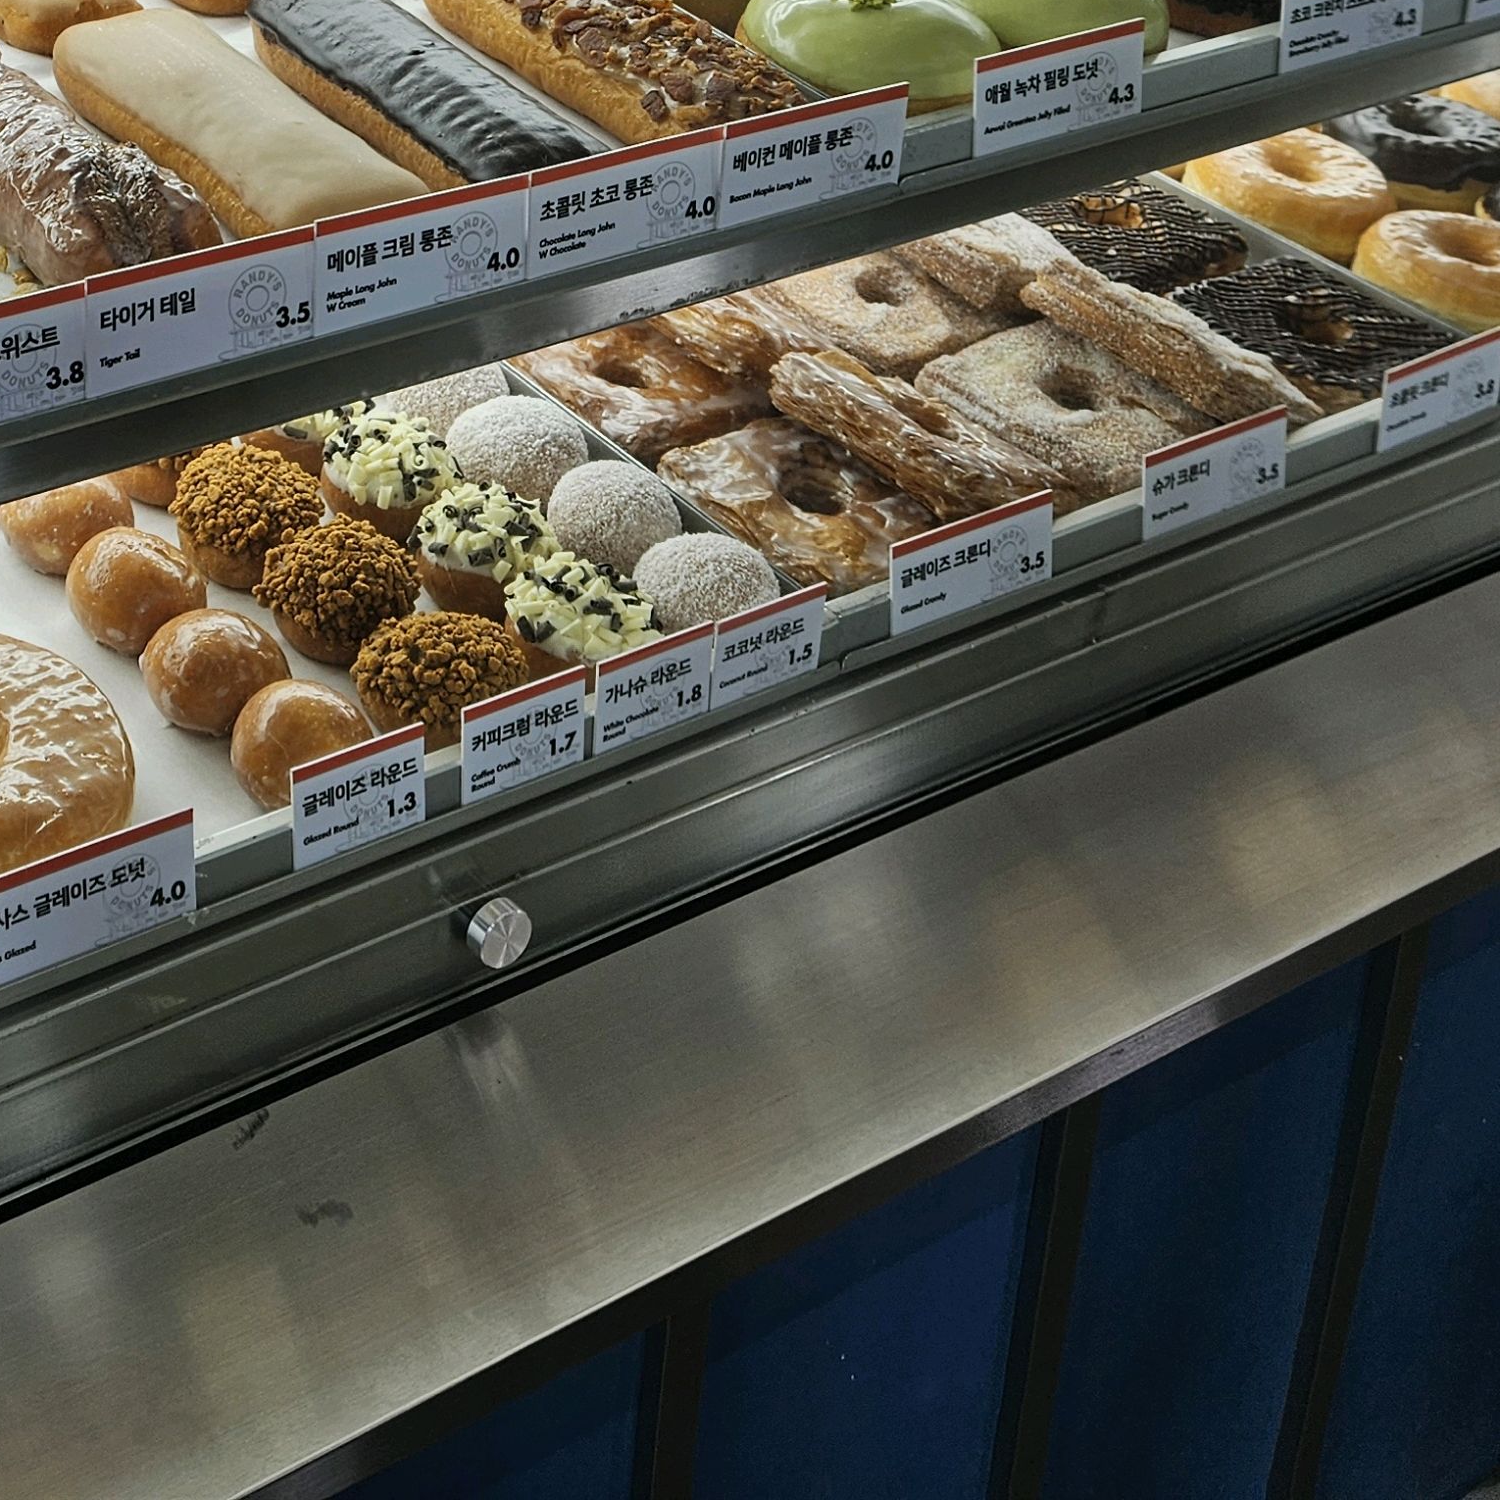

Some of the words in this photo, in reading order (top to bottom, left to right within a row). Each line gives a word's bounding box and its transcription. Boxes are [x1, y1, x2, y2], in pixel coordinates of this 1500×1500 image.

[985, 81, 1012, 105] 애월
[1014, 73, 1041, 97] 녹차
[1044, 65, 1070, 92] 필링
[1072, 58, 1099, 82] 도넛
[1108, 83, 1135, 105] 4.3
[732, 144, 775, 173] 베이컨
[779, 133, 822, 161] 메이플
[824, 126, 853, 151] 롱존
[864, 150, 894, 172] 4.0
[776, 180, 793, 191] Long
[795, 176, 812, 188] John
[539, 191, 585, 221] 초콜릿
[590, 184, 620, 209] 초코
[623, 174, 654, 200] 롱존
[685, 195, 715, 219] 4.0
[539, 232, 576, 248] Chocolate
[577, 227, 596, 238] Long
[597, 221, 615, 233] John
[327, 242, 378, 273] 메이플
[381, 233, 415, 260] 크림
[419, 225, 454, 252] 롱존
[486, 247, 520, 272] 4.0
[538, 250, 548, 260] W
[549, 240, 587, 256] Chocolate
[233, 271, 283, 300] RANDY'S
[326, 287, 354, 302] Maple
[355, 282, 375, 295] Long
[377, 276, 397, 289] John
[100, 298, 155, 331] 타이거
[160, 287, 196, 317] 테일
[275, 301, 311, 328] 3.5
[326, 303, 337, 313] W
[337, 297, 366, 311] Cream
[99, 355, 122, 369] Tiger
[123, 348, 141, 361] Tail
[45, 360, 85, 391] 3.8
[1152, 472, 1175, 496] 슈가
[1256, 463, 1280, 485] 3.5
[901, 555, 952, 589] 글레이즈
[953, 539, 991, 568] 크론디
[1020, 551, 1045, 574] 3.5
[721, 635, 762, 663] 코코넛
[765, 617, 805, 644] 라운드
[788, 643, 813, 666] 1.5
[605, 676, 648, 704] 가나슈
[650, 658, 693, 687] 라운드
[676, 684, 702, 708] 1.8
[472, 714, 531, 752] 커피크럼
[535, 698, 579, 728] 라운드
[602, 719, 625, 733] White
[549, 730, 577, 756] 1.7
[471, 768, 495, 783] Coffee
[496, 757, 521, 773] Crumb
[302, 776, 367, 818] 글레이즈
[370, 757, 419, 788] 라운드
[471, 777, 496, 793] Round
[387, 791, 418, 818] 1.3
[303, 827, 332, 846] Glazed
[333, 816, 360, 834] Round
[33, 874, 107, 919] 글레이즈
[109, 857, 146, 888] 도넛
[149, 880, 186, 908] 4.0
[4, 940, 37, 961] Glazed
